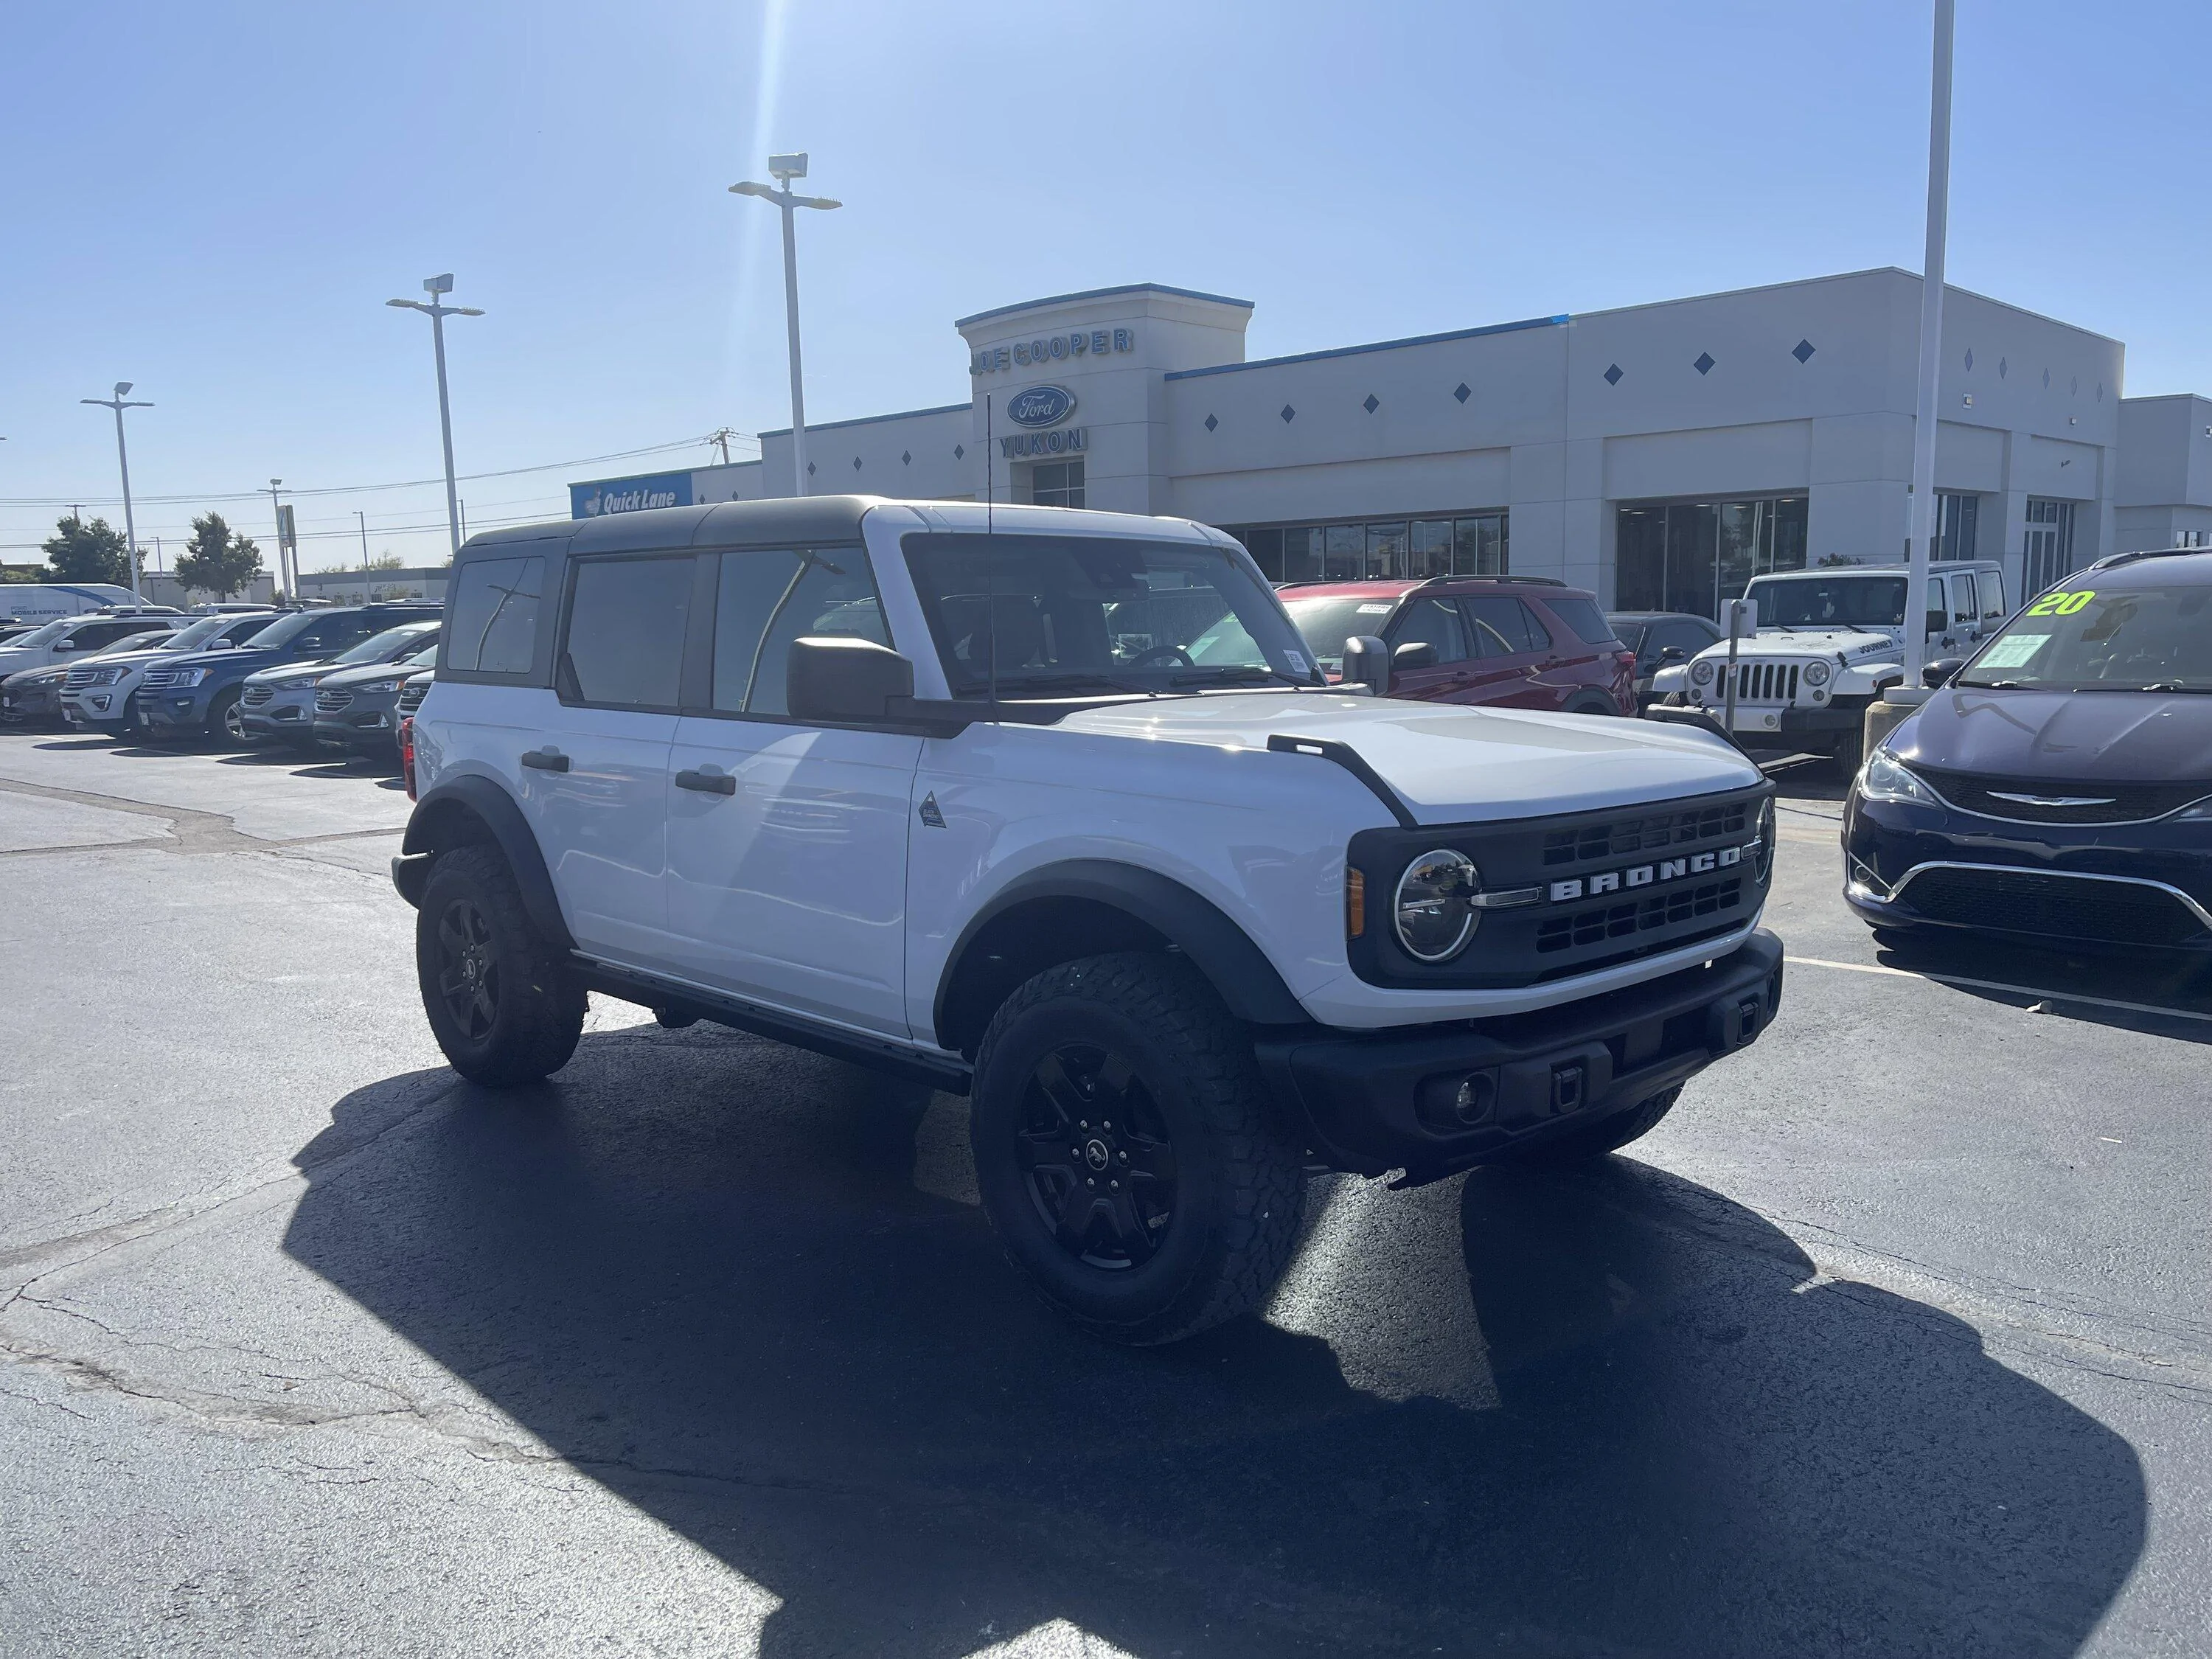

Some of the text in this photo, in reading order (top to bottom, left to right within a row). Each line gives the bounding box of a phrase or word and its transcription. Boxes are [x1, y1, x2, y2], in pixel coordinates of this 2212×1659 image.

[970, 328, 1133, 375] JOE COOPER
[1018, 394, 1055, 419] Ford
[999, 428, 1087, 459] YUKON
[604, 489, 675, 515] Quick Lane
[2025, 591, 2096, 616] 20
[1550, 847, 1740, 902] BRONCO
